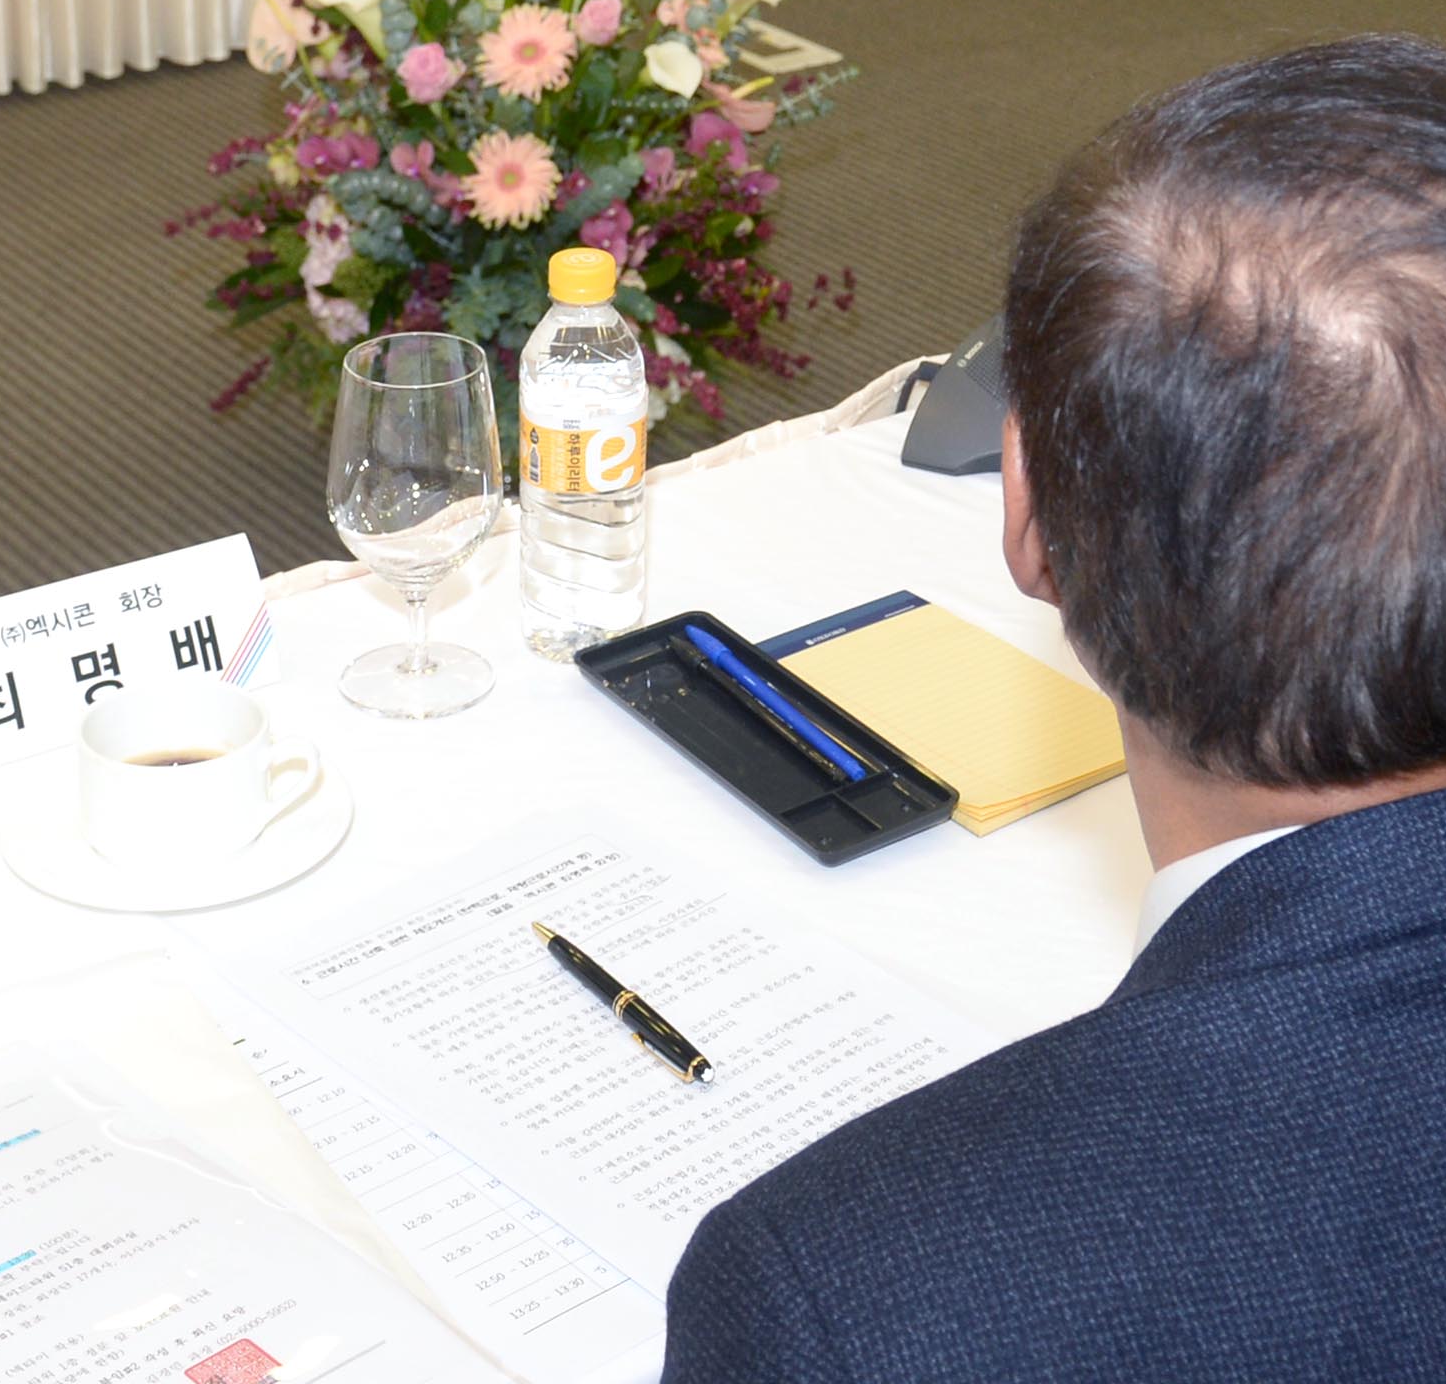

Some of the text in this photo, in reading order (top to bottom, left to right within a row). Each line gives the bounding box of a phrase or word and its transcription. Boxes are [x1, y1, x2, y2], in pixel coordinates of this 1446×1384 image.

[565, 432, 582, 493] 하루이리터
[117, 582, 166, 617] 회장
[71, 642, 125, 706] 명
[169, 614, 224, 674] 배
[314, 956, 361, 978] 근로시간
[313, 1134, 337, 1151] 2:10
[344, 1142, 417, 1182] 12:15 12:20
[402, 1212, 433, 1232] 12:20
[441, 1221, 516, 1264] 12:35 12:50
[475, 1249, 551, 1292] 12:50 13:25
[509, 1276, 585, 1320] 13:25 13:30
